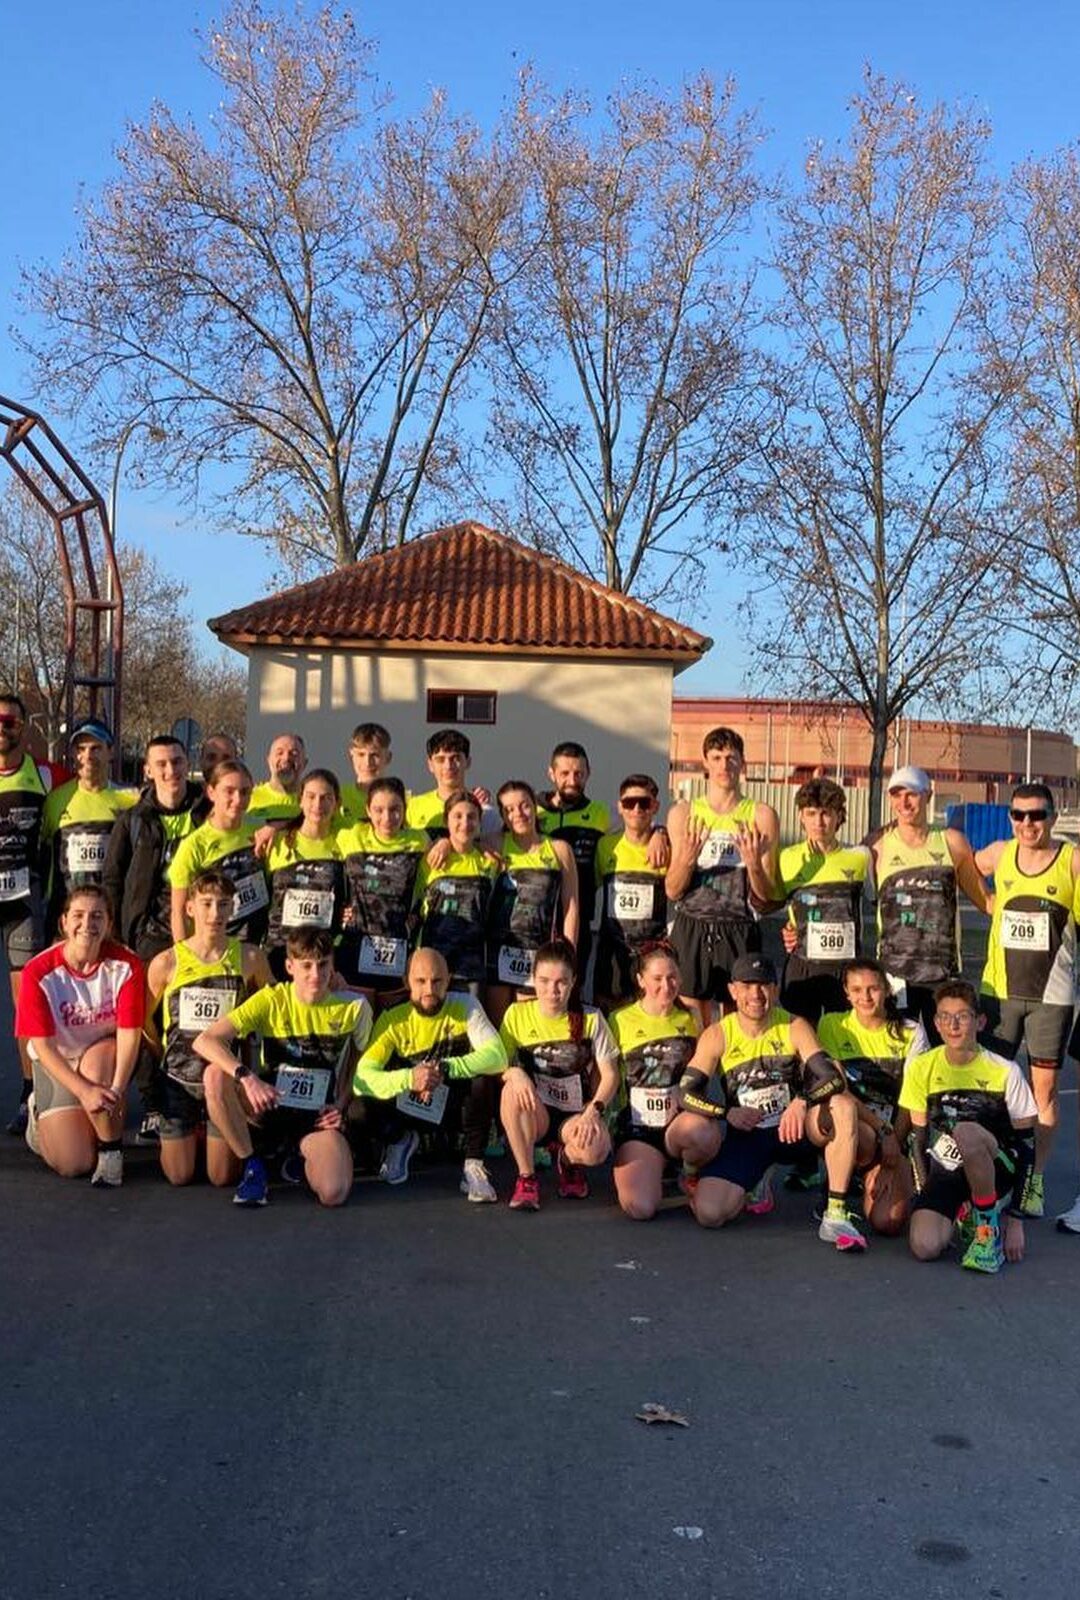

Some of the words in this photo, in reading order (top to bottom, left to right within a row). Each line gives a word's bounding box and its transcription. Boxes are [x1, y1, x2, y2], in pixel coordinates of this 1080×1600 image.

[81, 846, 105, 860] 366
[0, 876, 16, 890] 16
[619, 895, 640, 908] 347
[298, 902, 319, 916] 164
[1010, 923, 1035, 938] 209
[820, 934, 845, 948] 380
[373, 949, 396, 964] 327
[194, 1002, 220, 1019] 367
[291, 1079, 314, 1096] 261
[943, 1144, 963, 1161] 20
